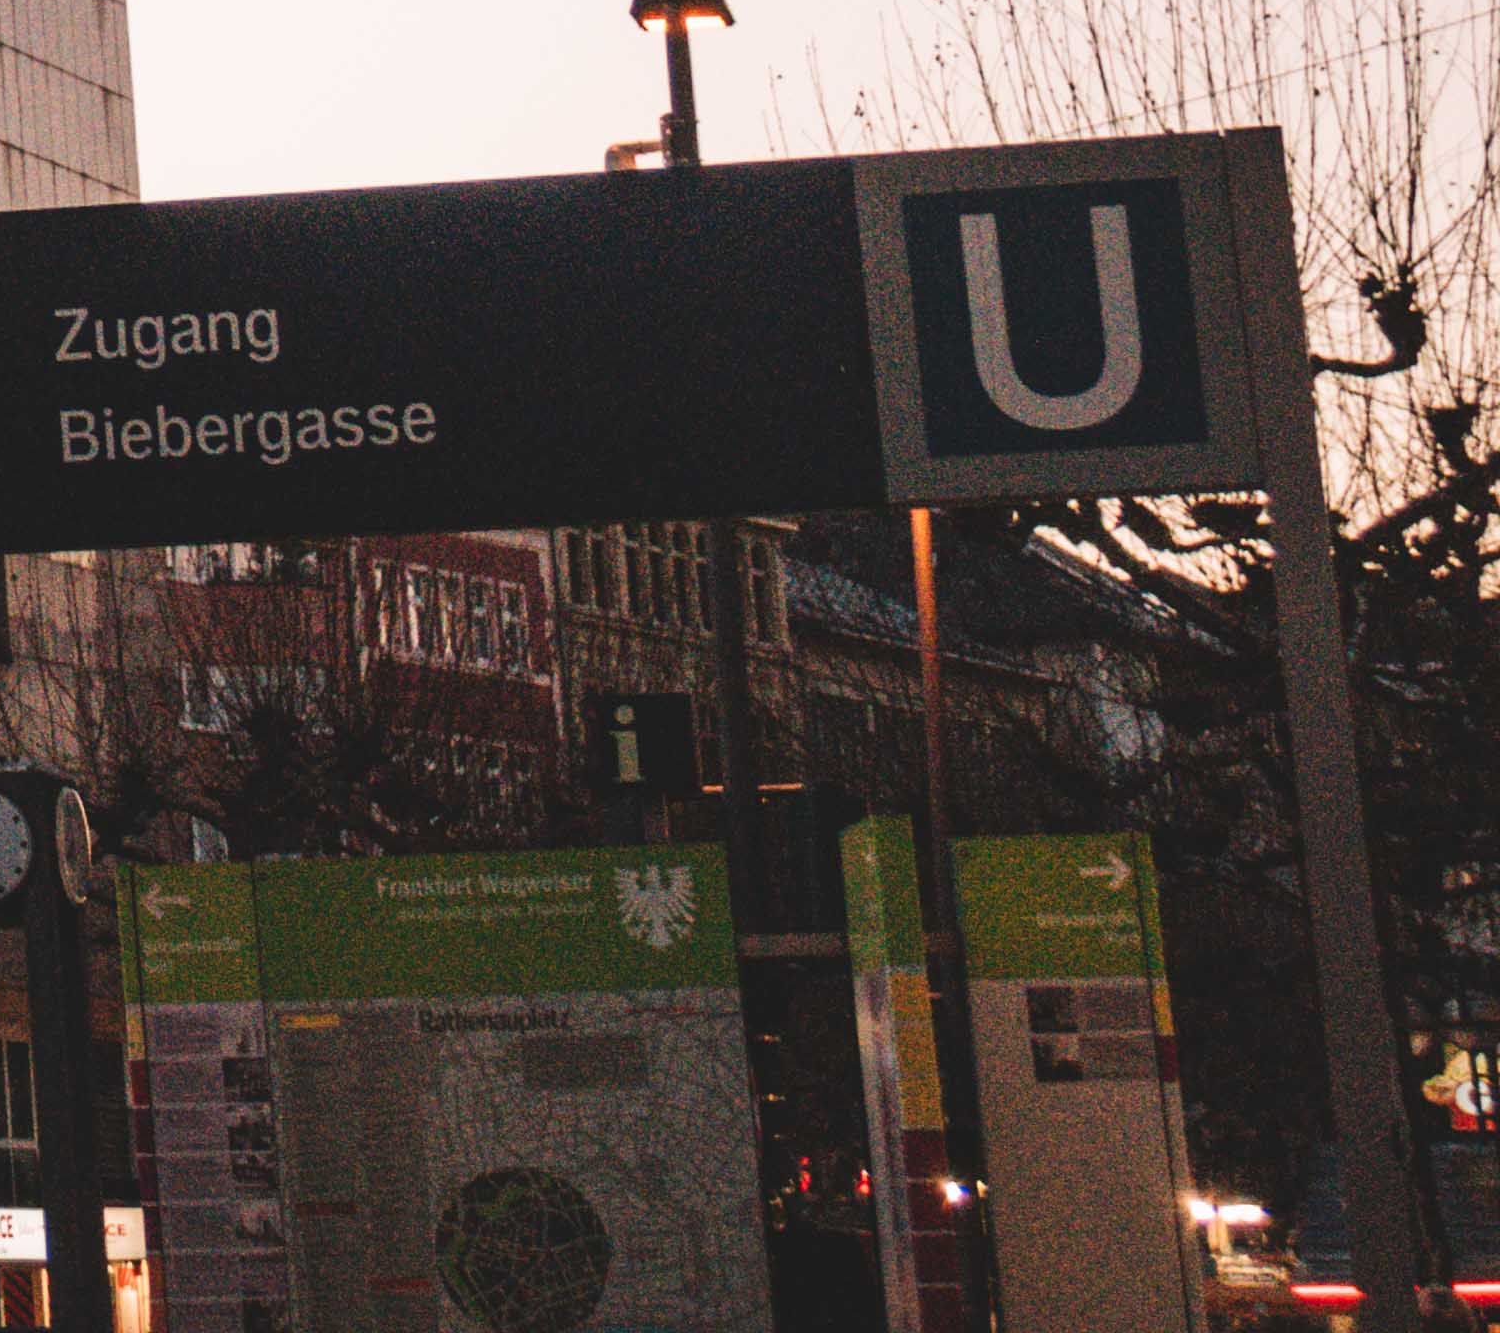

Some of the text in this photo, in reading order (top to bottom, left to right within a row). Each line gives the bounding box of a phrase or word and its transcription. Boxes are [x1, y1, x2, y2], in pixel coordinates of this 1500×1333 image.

[54, 305, 282, 368] Zugang
[959, 204, 1143, 432] U
[59, 401, 437, 466] Biebergasse
